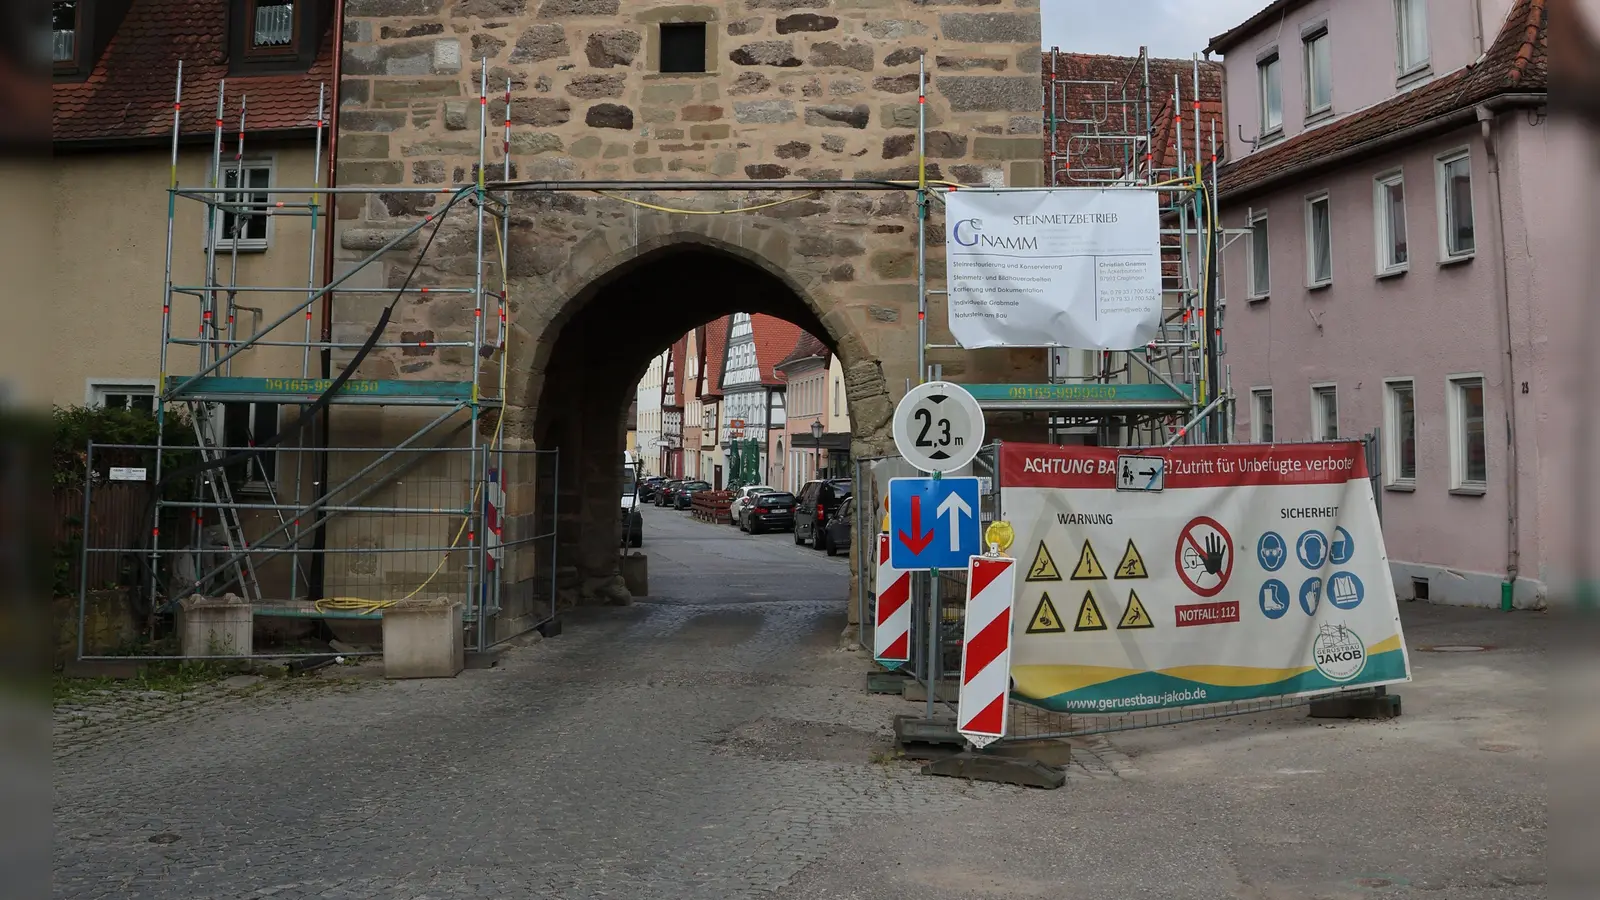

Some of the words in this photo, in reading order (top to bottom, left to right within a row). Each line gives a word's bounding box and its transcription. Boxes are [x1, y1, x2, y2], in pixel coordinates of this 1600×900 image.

[1013, 213, 1118, 226] STEINMETZBETRIEB
[953, 218, 1038, 250] GNAMM
[265, 379, 379, 392] 09165-999550
[1009, 386, 1116, 398] 09165-9959550
[914, 408, 950, 448] 2,3
[954, 437, 964, 446] m
[1024, 458, 1094, 474] ACHTUNG
[1175, 458, 1214, 474] Zutritt
[1216, 458, 1235, 474] für
[1238, 456, 1302, 474] Unbefugte
[1057, 514, 1114, 525] WARNUNG
[1280, 506, 1339, 519] SICHERHEIT
[1179, 610, 1220, 622] NOTFALL:
[1221, 606, 1236, 618] 112
[1318, 650, 1362, 664] JAKOB
[1066, 687, 1206, 710] www.geruestbau-jakob.de
